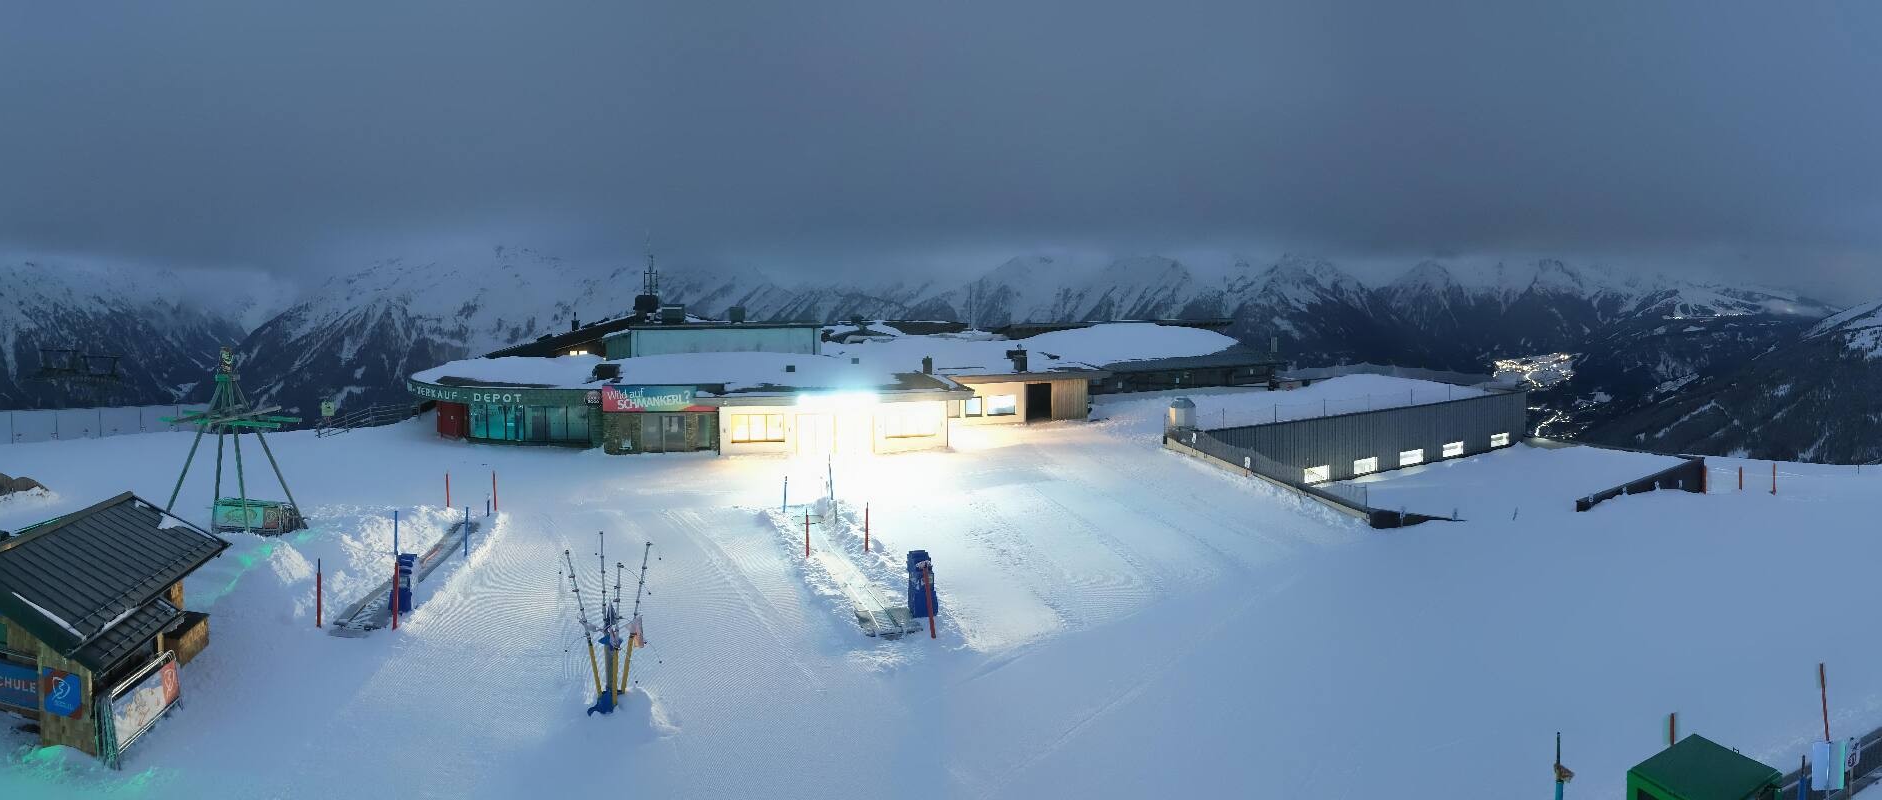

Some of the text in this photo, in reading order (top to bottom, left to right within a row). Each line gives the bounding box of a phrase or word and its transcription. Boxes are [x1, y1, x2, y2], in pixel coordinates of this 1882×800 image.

[473, 393, 522, 403] DEPOT
[607, 389, 628, 400] Wild
[629, 387, 645, 399] auf
[617, 390, 691, 410] SCHMANKERL?
